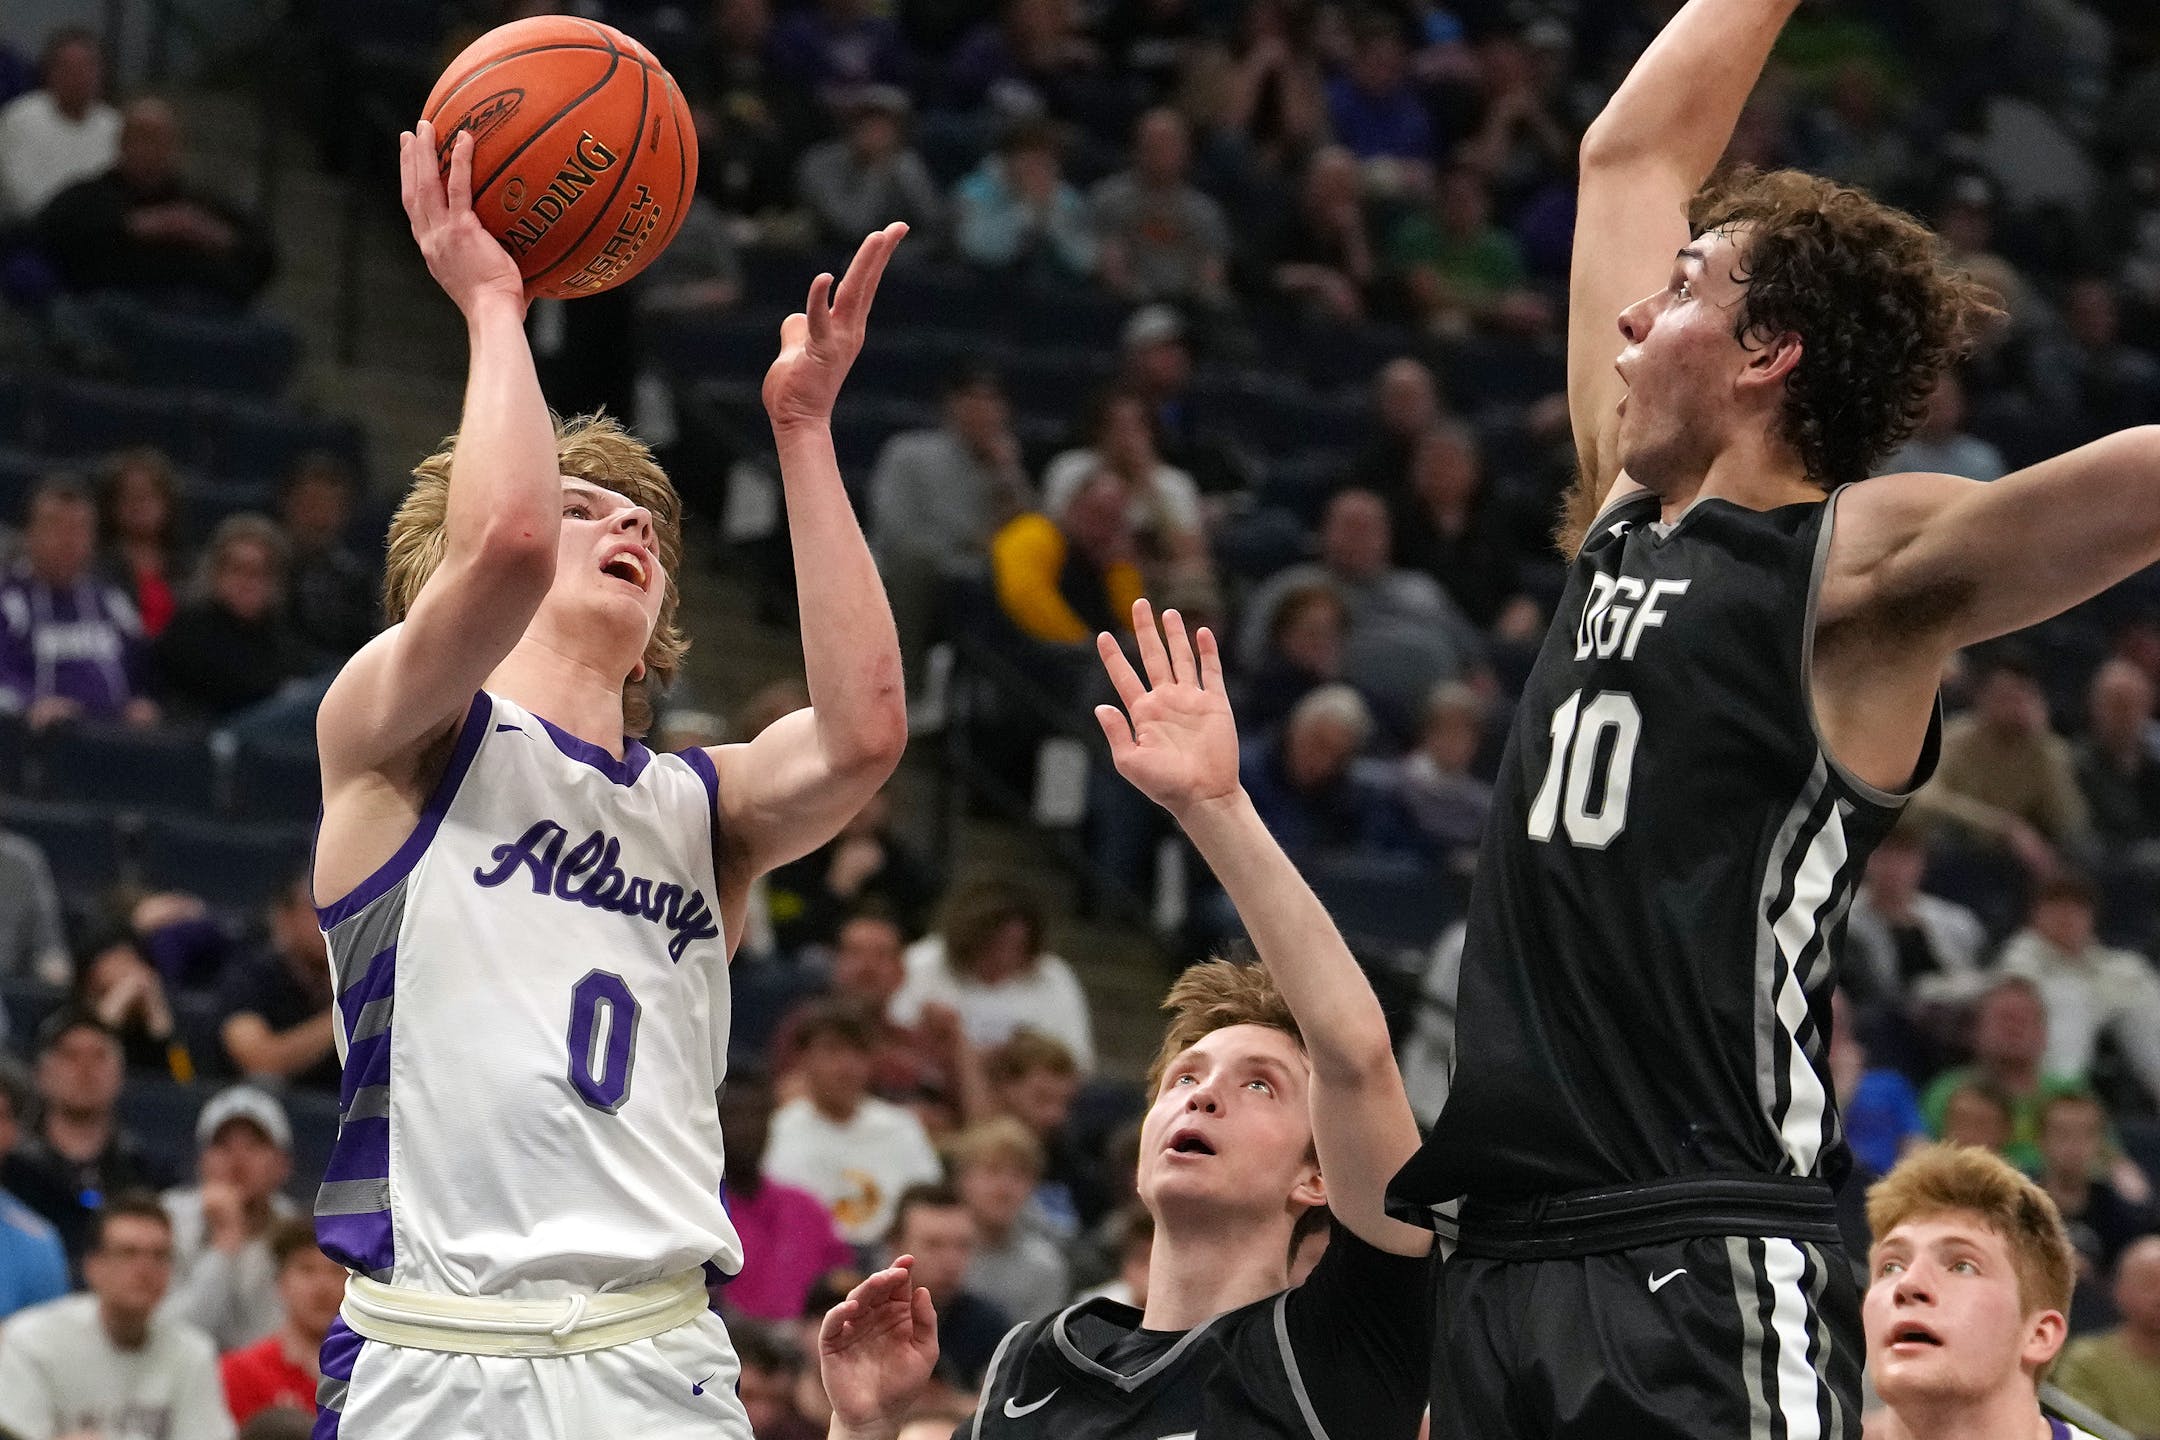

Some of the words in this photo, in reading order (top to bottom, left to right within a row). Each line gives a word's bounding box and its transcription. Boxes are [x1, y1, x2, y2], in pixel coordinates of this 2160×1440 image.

[556, 184, 653, 292] EGACY
[1573, 570, 1693, 662] DGF
[1527, 687, 1643, 850] 10
[473, 818, 719, 964] Albany
[566, 967, 642, 1116] 0
